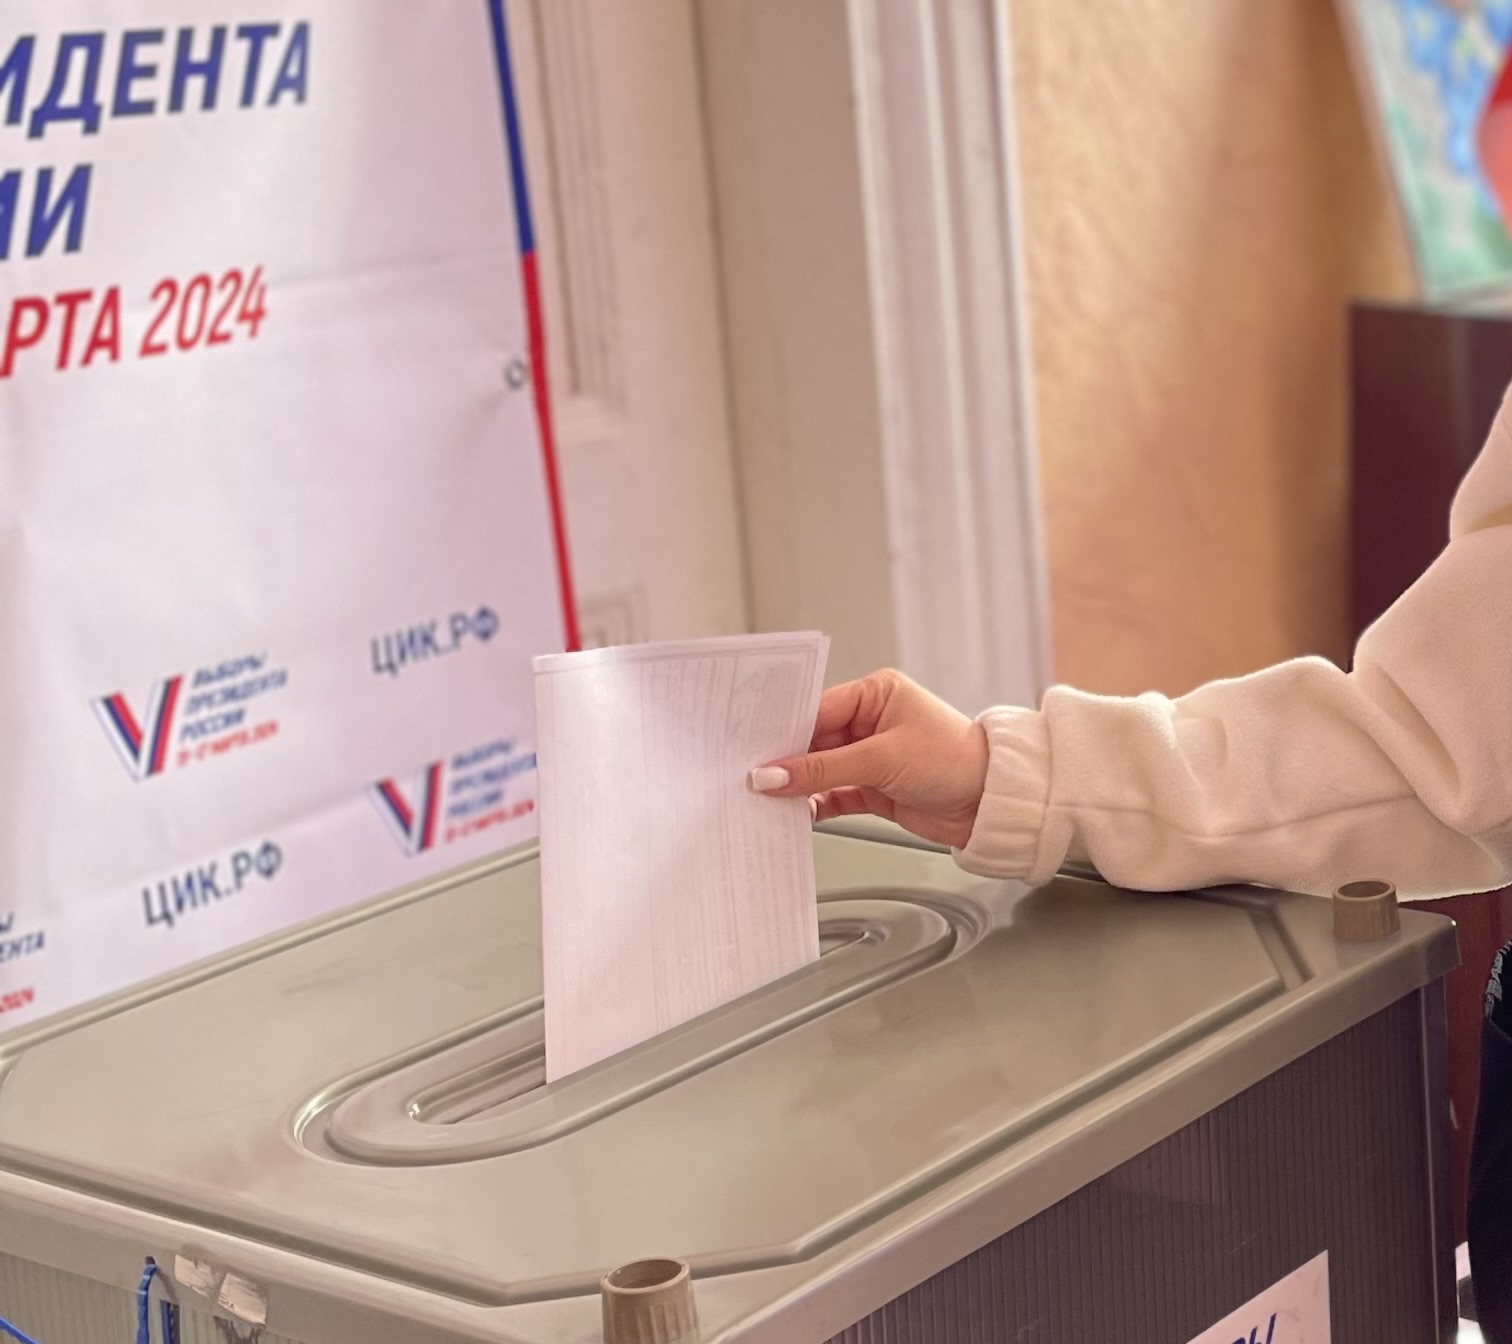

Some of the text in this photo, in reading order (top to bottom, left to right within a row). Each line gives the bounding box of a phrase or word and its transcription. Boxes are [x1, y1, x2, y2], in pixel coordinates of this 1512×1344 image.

[139, 265, 268, 358] 2024
[370, 604, 500, 679] ЦИК.РФ
[142, 839, 283, 929] ЦИК.РФ
